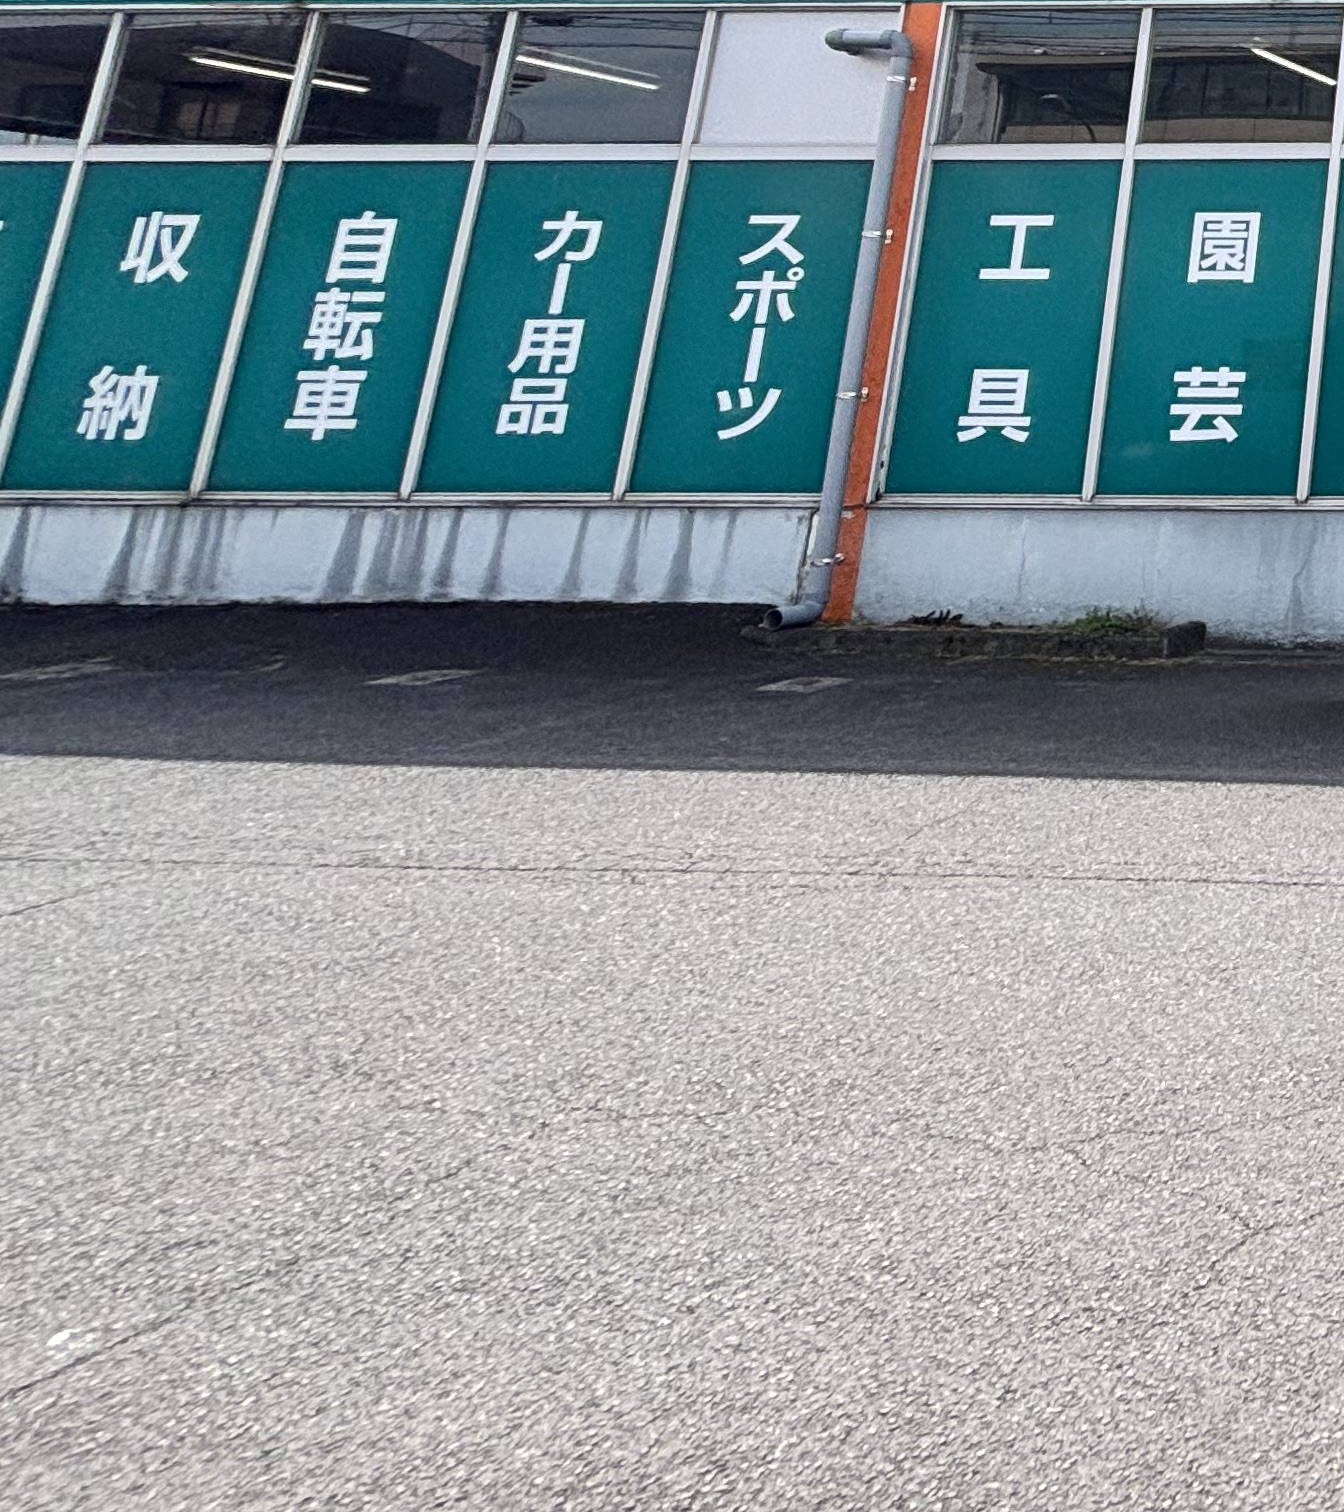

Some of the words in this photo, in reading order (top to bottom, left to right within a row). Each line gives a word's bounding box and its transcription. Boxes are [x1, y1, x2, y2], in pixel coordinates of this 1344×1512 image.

[284, 211, 398, 440] 自転車
[496, 211, 602, 435] カー用品
[717, 214, 805, 440] スポーツ
